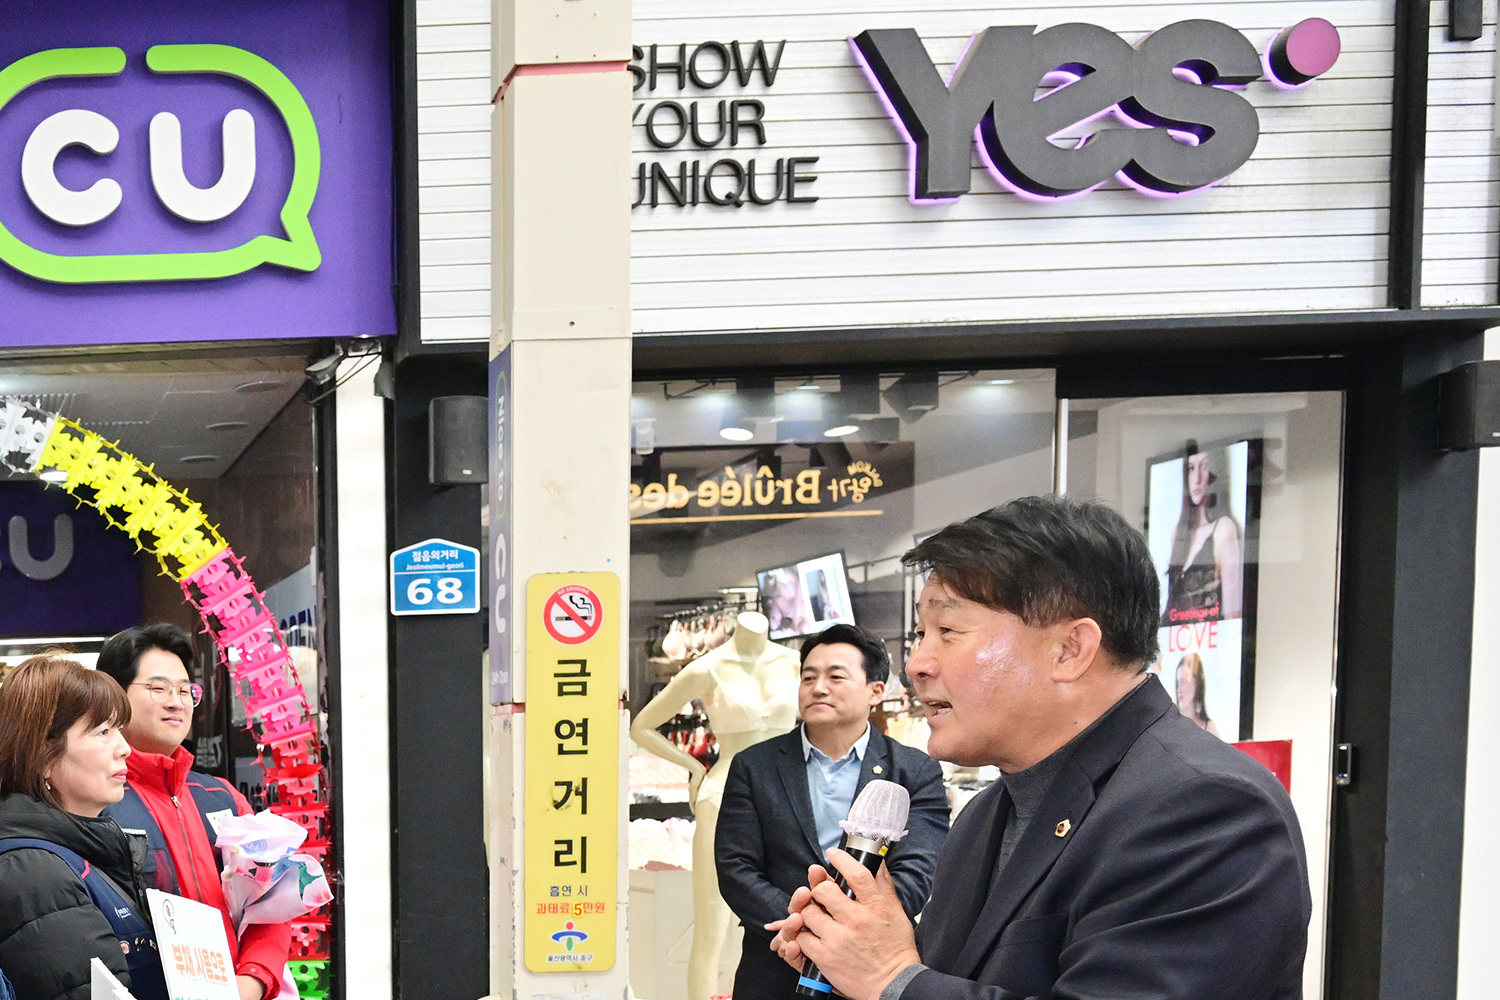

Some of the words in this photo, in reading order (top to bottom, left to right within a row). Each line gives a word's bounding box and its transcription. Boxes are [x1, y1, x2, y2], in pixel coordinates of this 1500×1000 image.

[632, 100, 767, 149] OUR
[22, 109, 257, 226] CU
[407, 577, 463, 605] 68
[1168, 620, 1218, 652] LOVE
[553, 658, 592, 874] 금연거리
[550, 885, 572, 897] 흡연
[577, 885, 588, 896] 시
[536, 903, 570, 914] 과태료
[573, 902, 605, 916] 5만원
[172, 944, 196, 977] 부채
[194, 947, 228, 982] 사용으로
